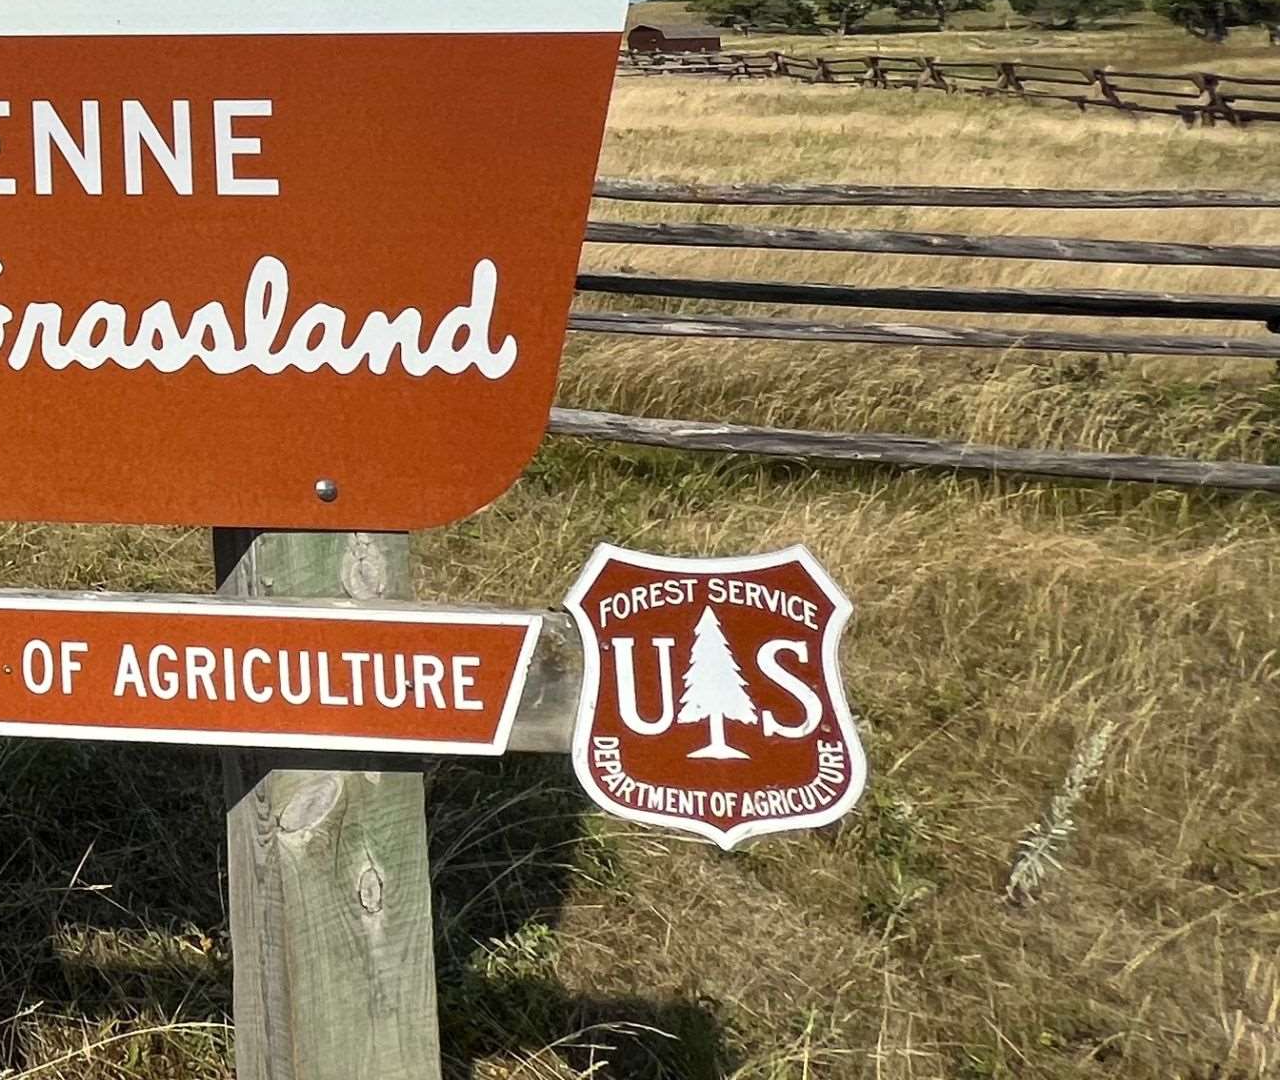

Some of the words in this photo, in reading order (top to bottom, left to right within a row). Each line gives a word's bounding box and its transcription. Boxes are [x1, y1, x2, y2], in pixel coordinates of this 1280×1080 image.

[599, 578, 699, 629] FOREST
[707, 577, 820, 631] SERVICE
[22, 639, 89, 695] OF
[112, 643, 485, 711] AGRICULTURE
[592, 736, 706, 817] DEPARTMENT
[709, 790, 738, 818] OF
[741, 739, 846, 818] AGRICULTURE
